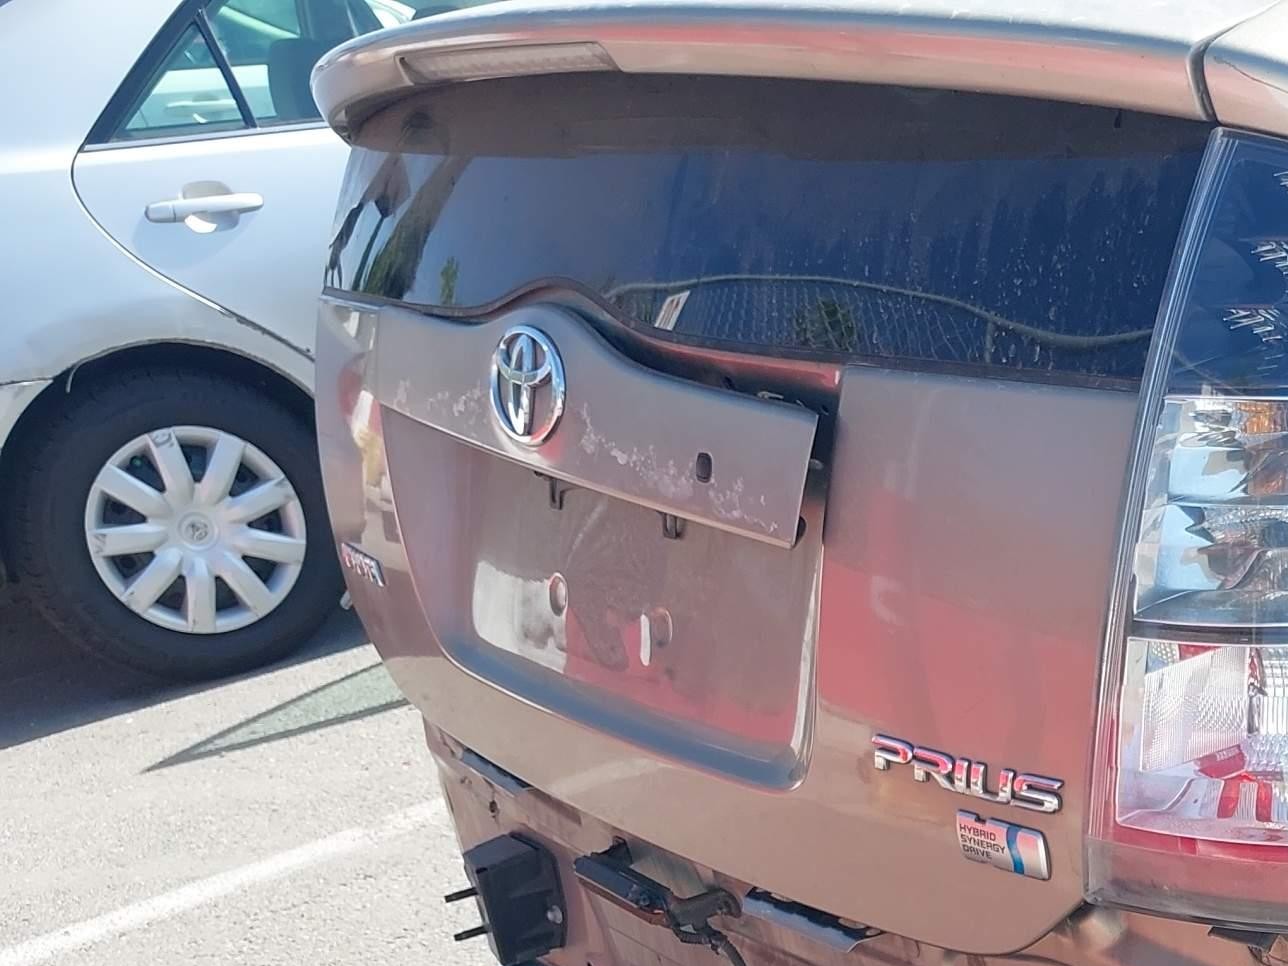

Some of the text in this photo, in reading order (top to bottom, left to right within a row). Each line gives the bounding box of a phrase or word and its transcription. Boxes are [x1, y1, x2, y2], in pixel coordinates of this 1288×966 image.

[871, 733, 1064, 814] PRIUS
[959, 823, 997, 842] HYBRID
[960, 834, 1006, 855] SYNERGY
[962, 844, 993, 860] DRIVE
